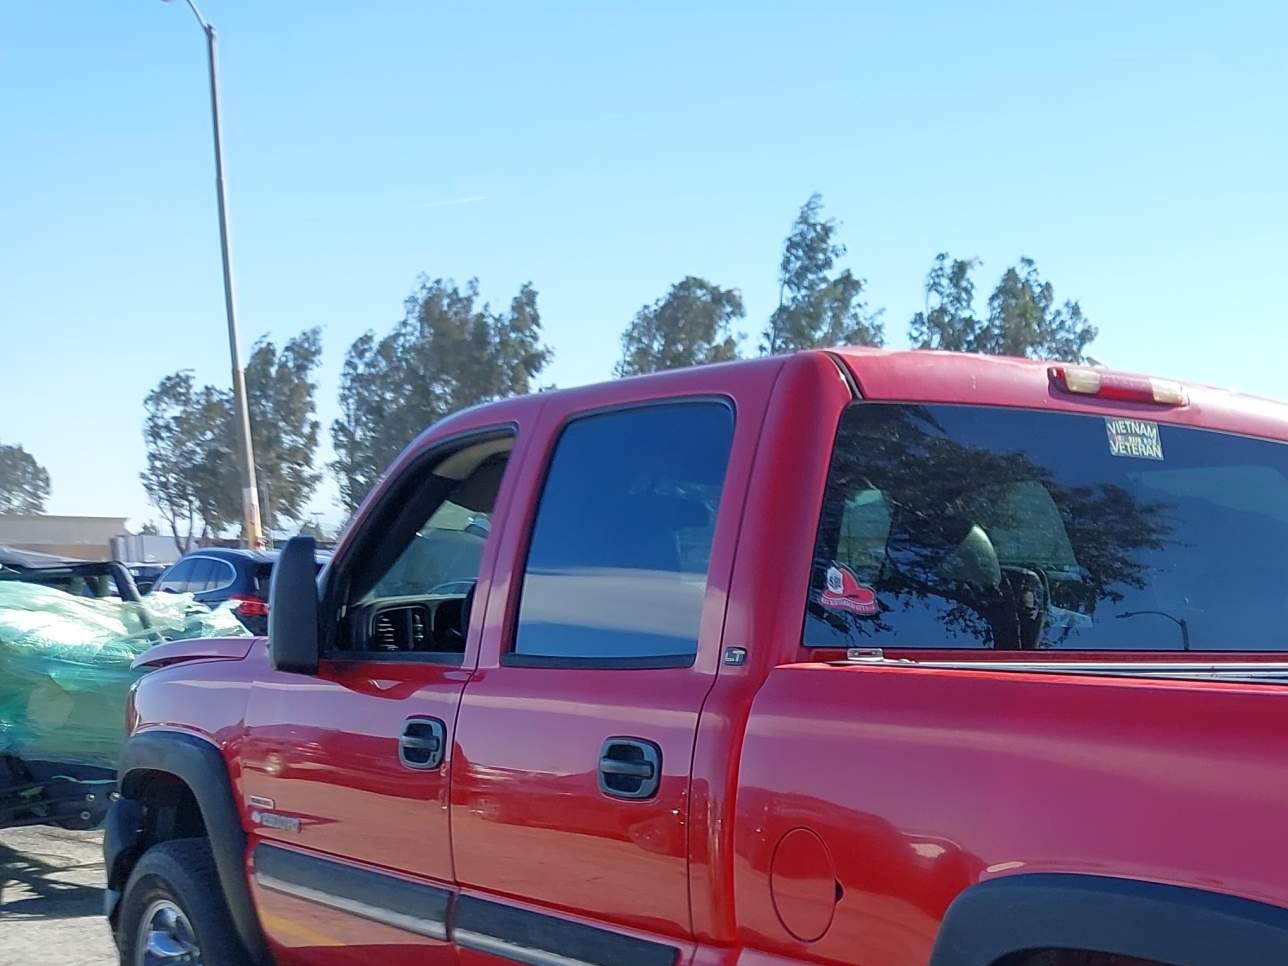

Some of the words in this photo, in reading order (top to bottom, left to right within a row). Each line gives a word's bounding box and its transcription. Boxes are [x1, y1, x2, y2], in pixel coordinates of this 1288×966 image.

[1106, 419, 1157, 440] VIETNAM
[1109, 439, 1162, 459] VETERAN
[724, 650, 746, 663] LT
